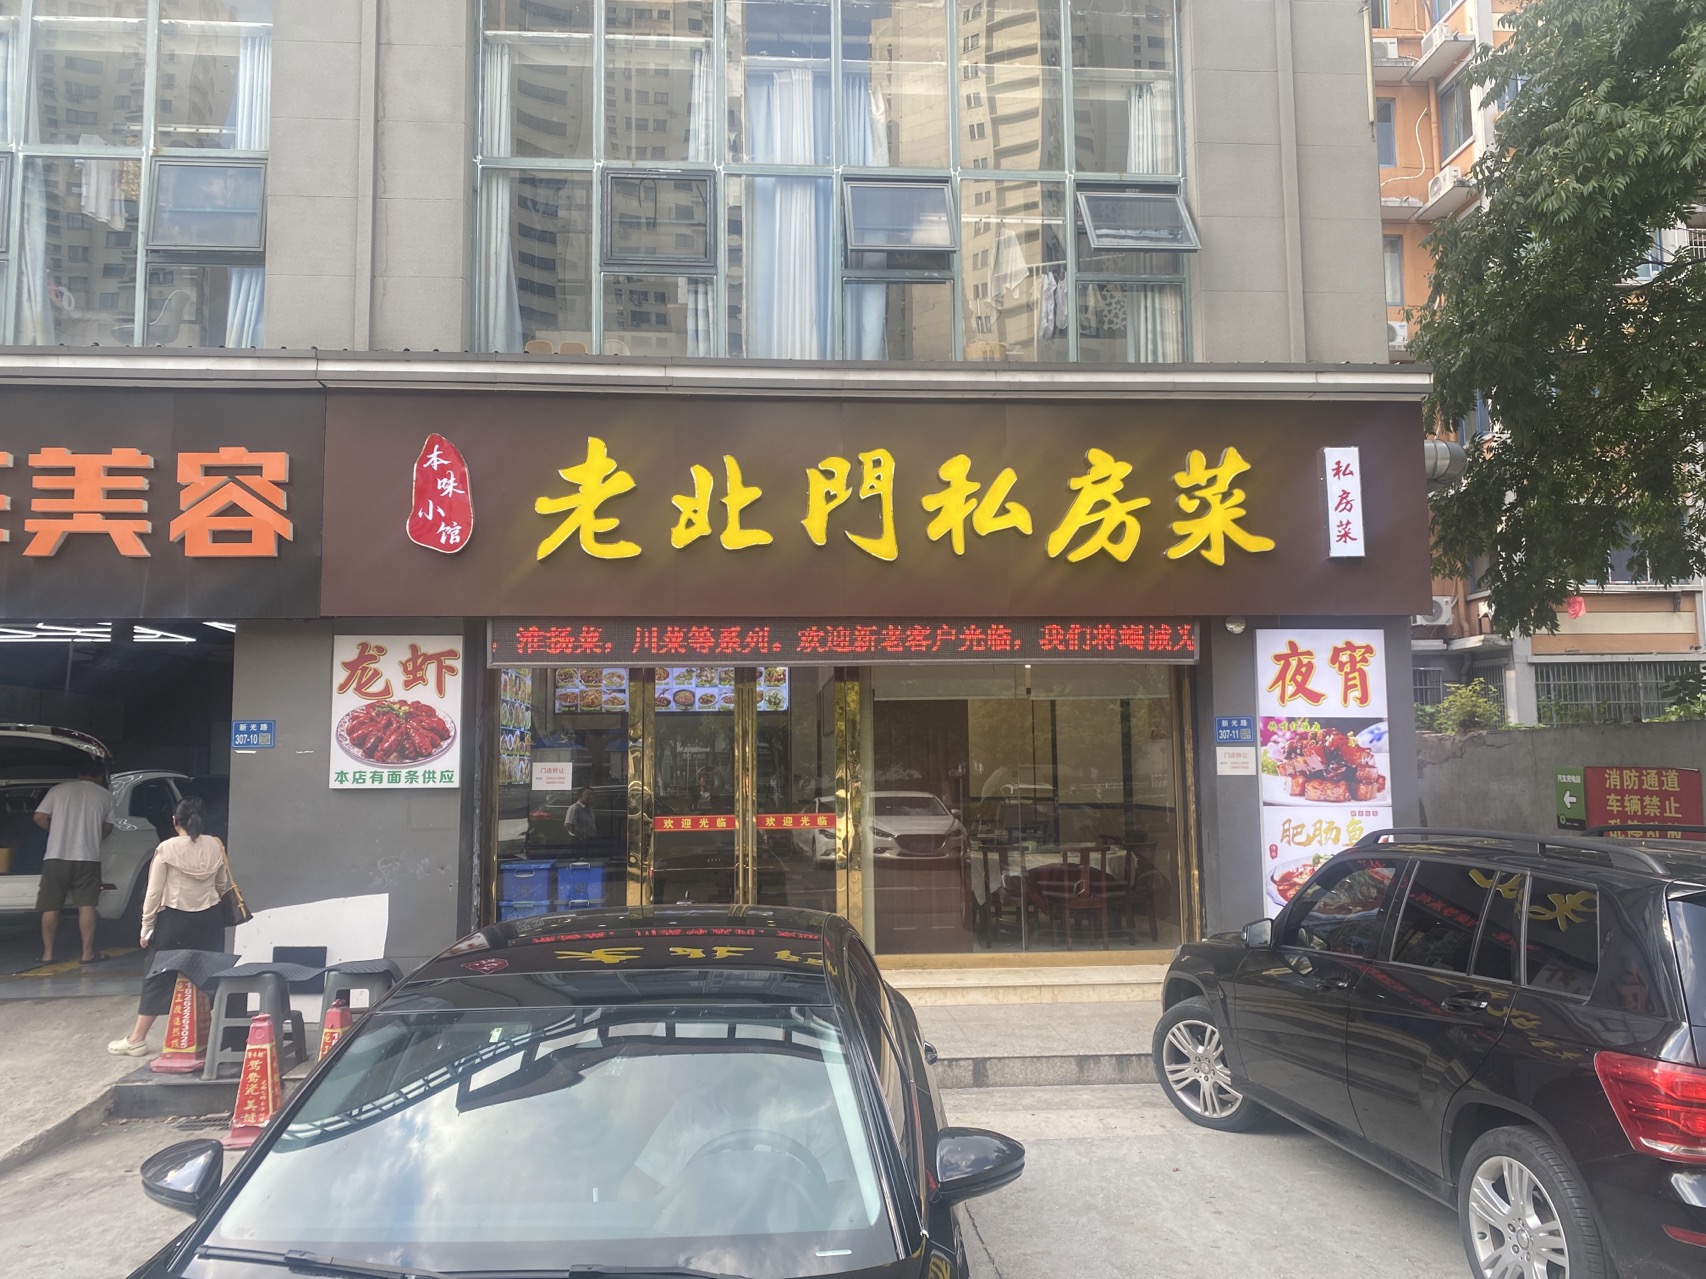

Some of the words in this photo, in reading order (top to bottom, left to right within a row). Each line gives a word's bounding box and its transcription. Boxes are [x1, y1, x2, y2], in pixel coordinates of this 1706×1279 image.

[0, 446, 294, 557] 美容
[418, 444, 466, 545] 本味小馆
[534, 436, 1276, 566] 老北門私房菜
[1332, 459, 1358, 544] 私房菜
[336, 641, 461, 700] 龙虾
[1266, 640, 1376, 707] 夜宵
[239, 723, 268, 732] 新光路
[1218, 729, 1240, 740] 307-11
[1221, 719, 1248, 727] 新光路
[234, 733, 259, 745] 307-10
[334, 769, 455, 785] 本店有面条供应
[1604, 768, 1681, 792] 消防通道
[1606, 793, 1683, 818] 车辆禁止
[663, 818, 727, 829] 欢迎光临
[765, 815, 828, 827] 欢迎光临
[1280, 816, 1365, 848] 肥肠鱼
